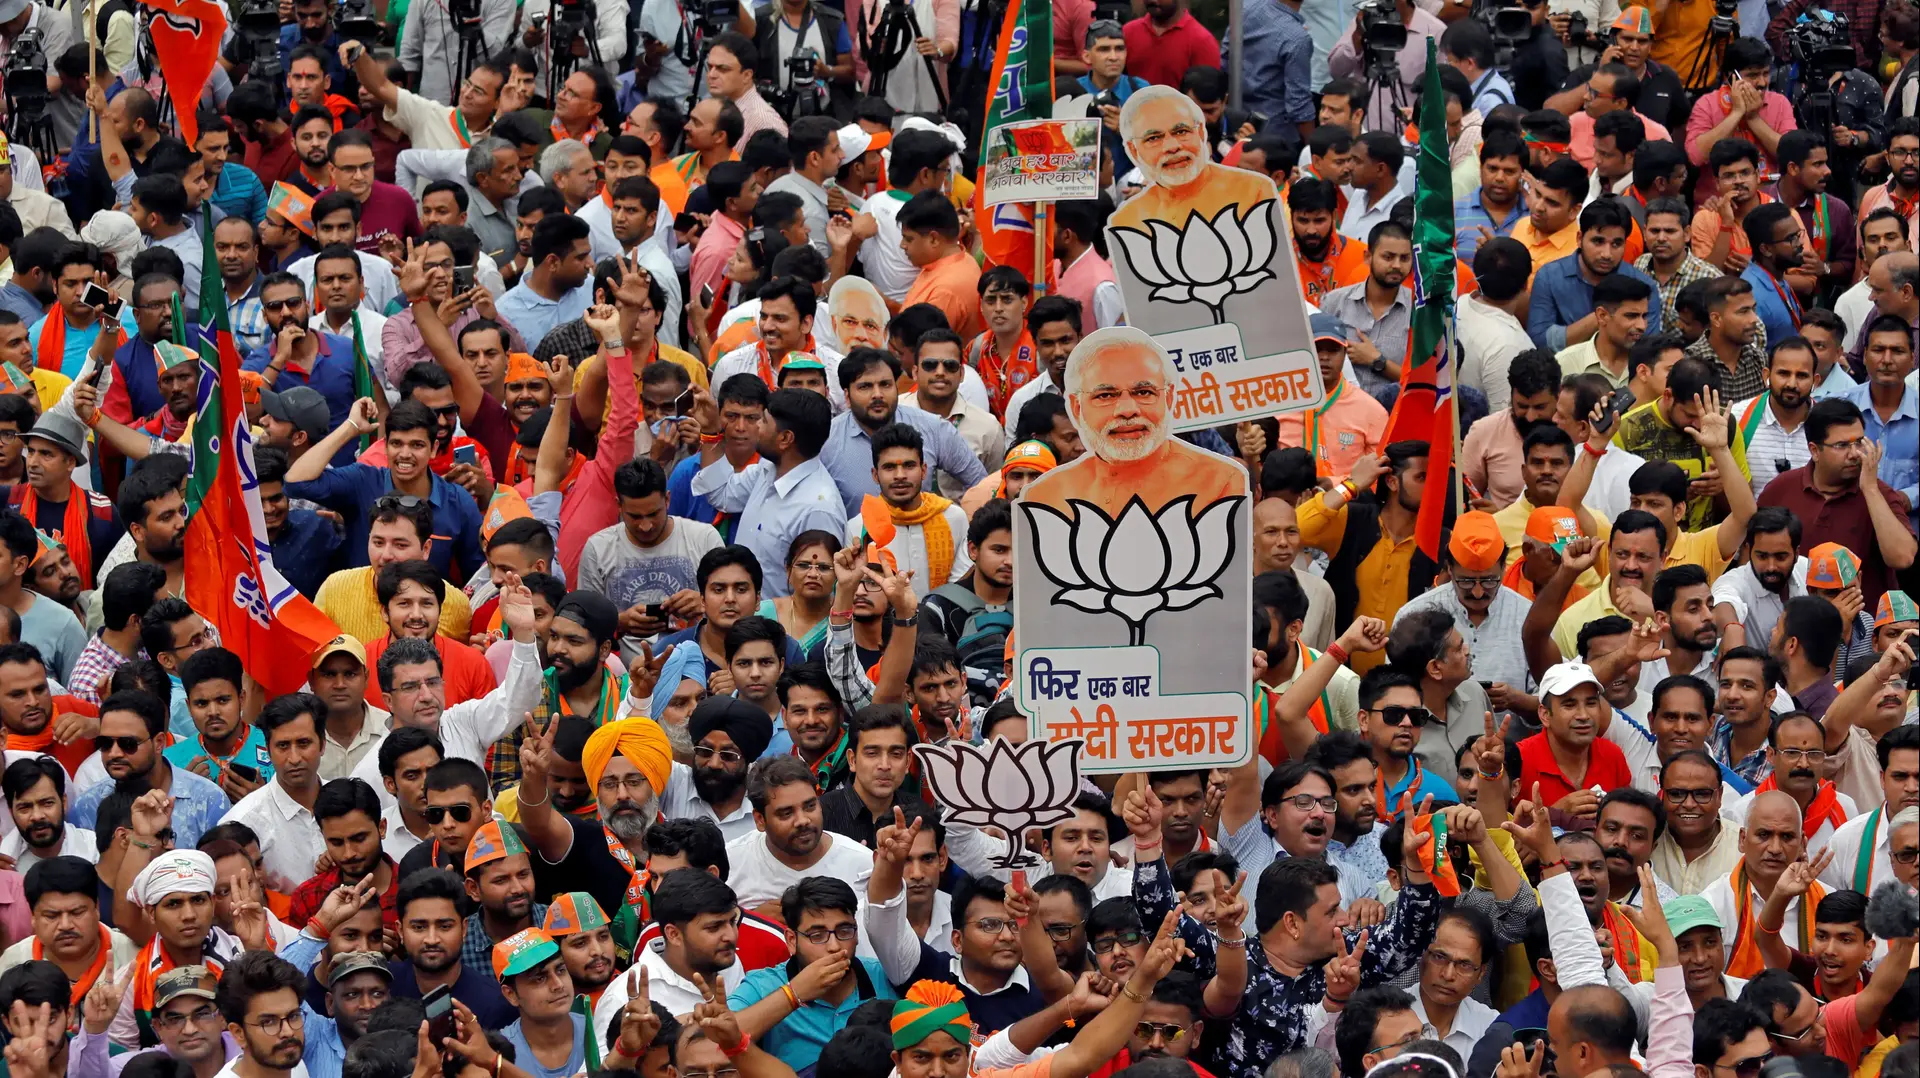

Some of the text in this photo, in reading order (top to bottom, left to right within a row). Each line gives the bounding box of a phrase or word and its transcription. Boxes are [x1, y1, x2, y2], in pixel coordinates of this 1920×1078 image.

[1026, 154, 1047, 169] हर
[1050, 153, 1077, 169] बार
[1032, 171, 1087, 186] सरकार
[1189, 350, 1213, 370] एक
[1214, 345, 1239, 364] बार
[1225, 367, 1313, 412] सरकार
[621, 574, 647, 603] BARE
[1028, 656, 1151, 701] फिर एक बार
[1127, 715, 1238, 760] सरकार
